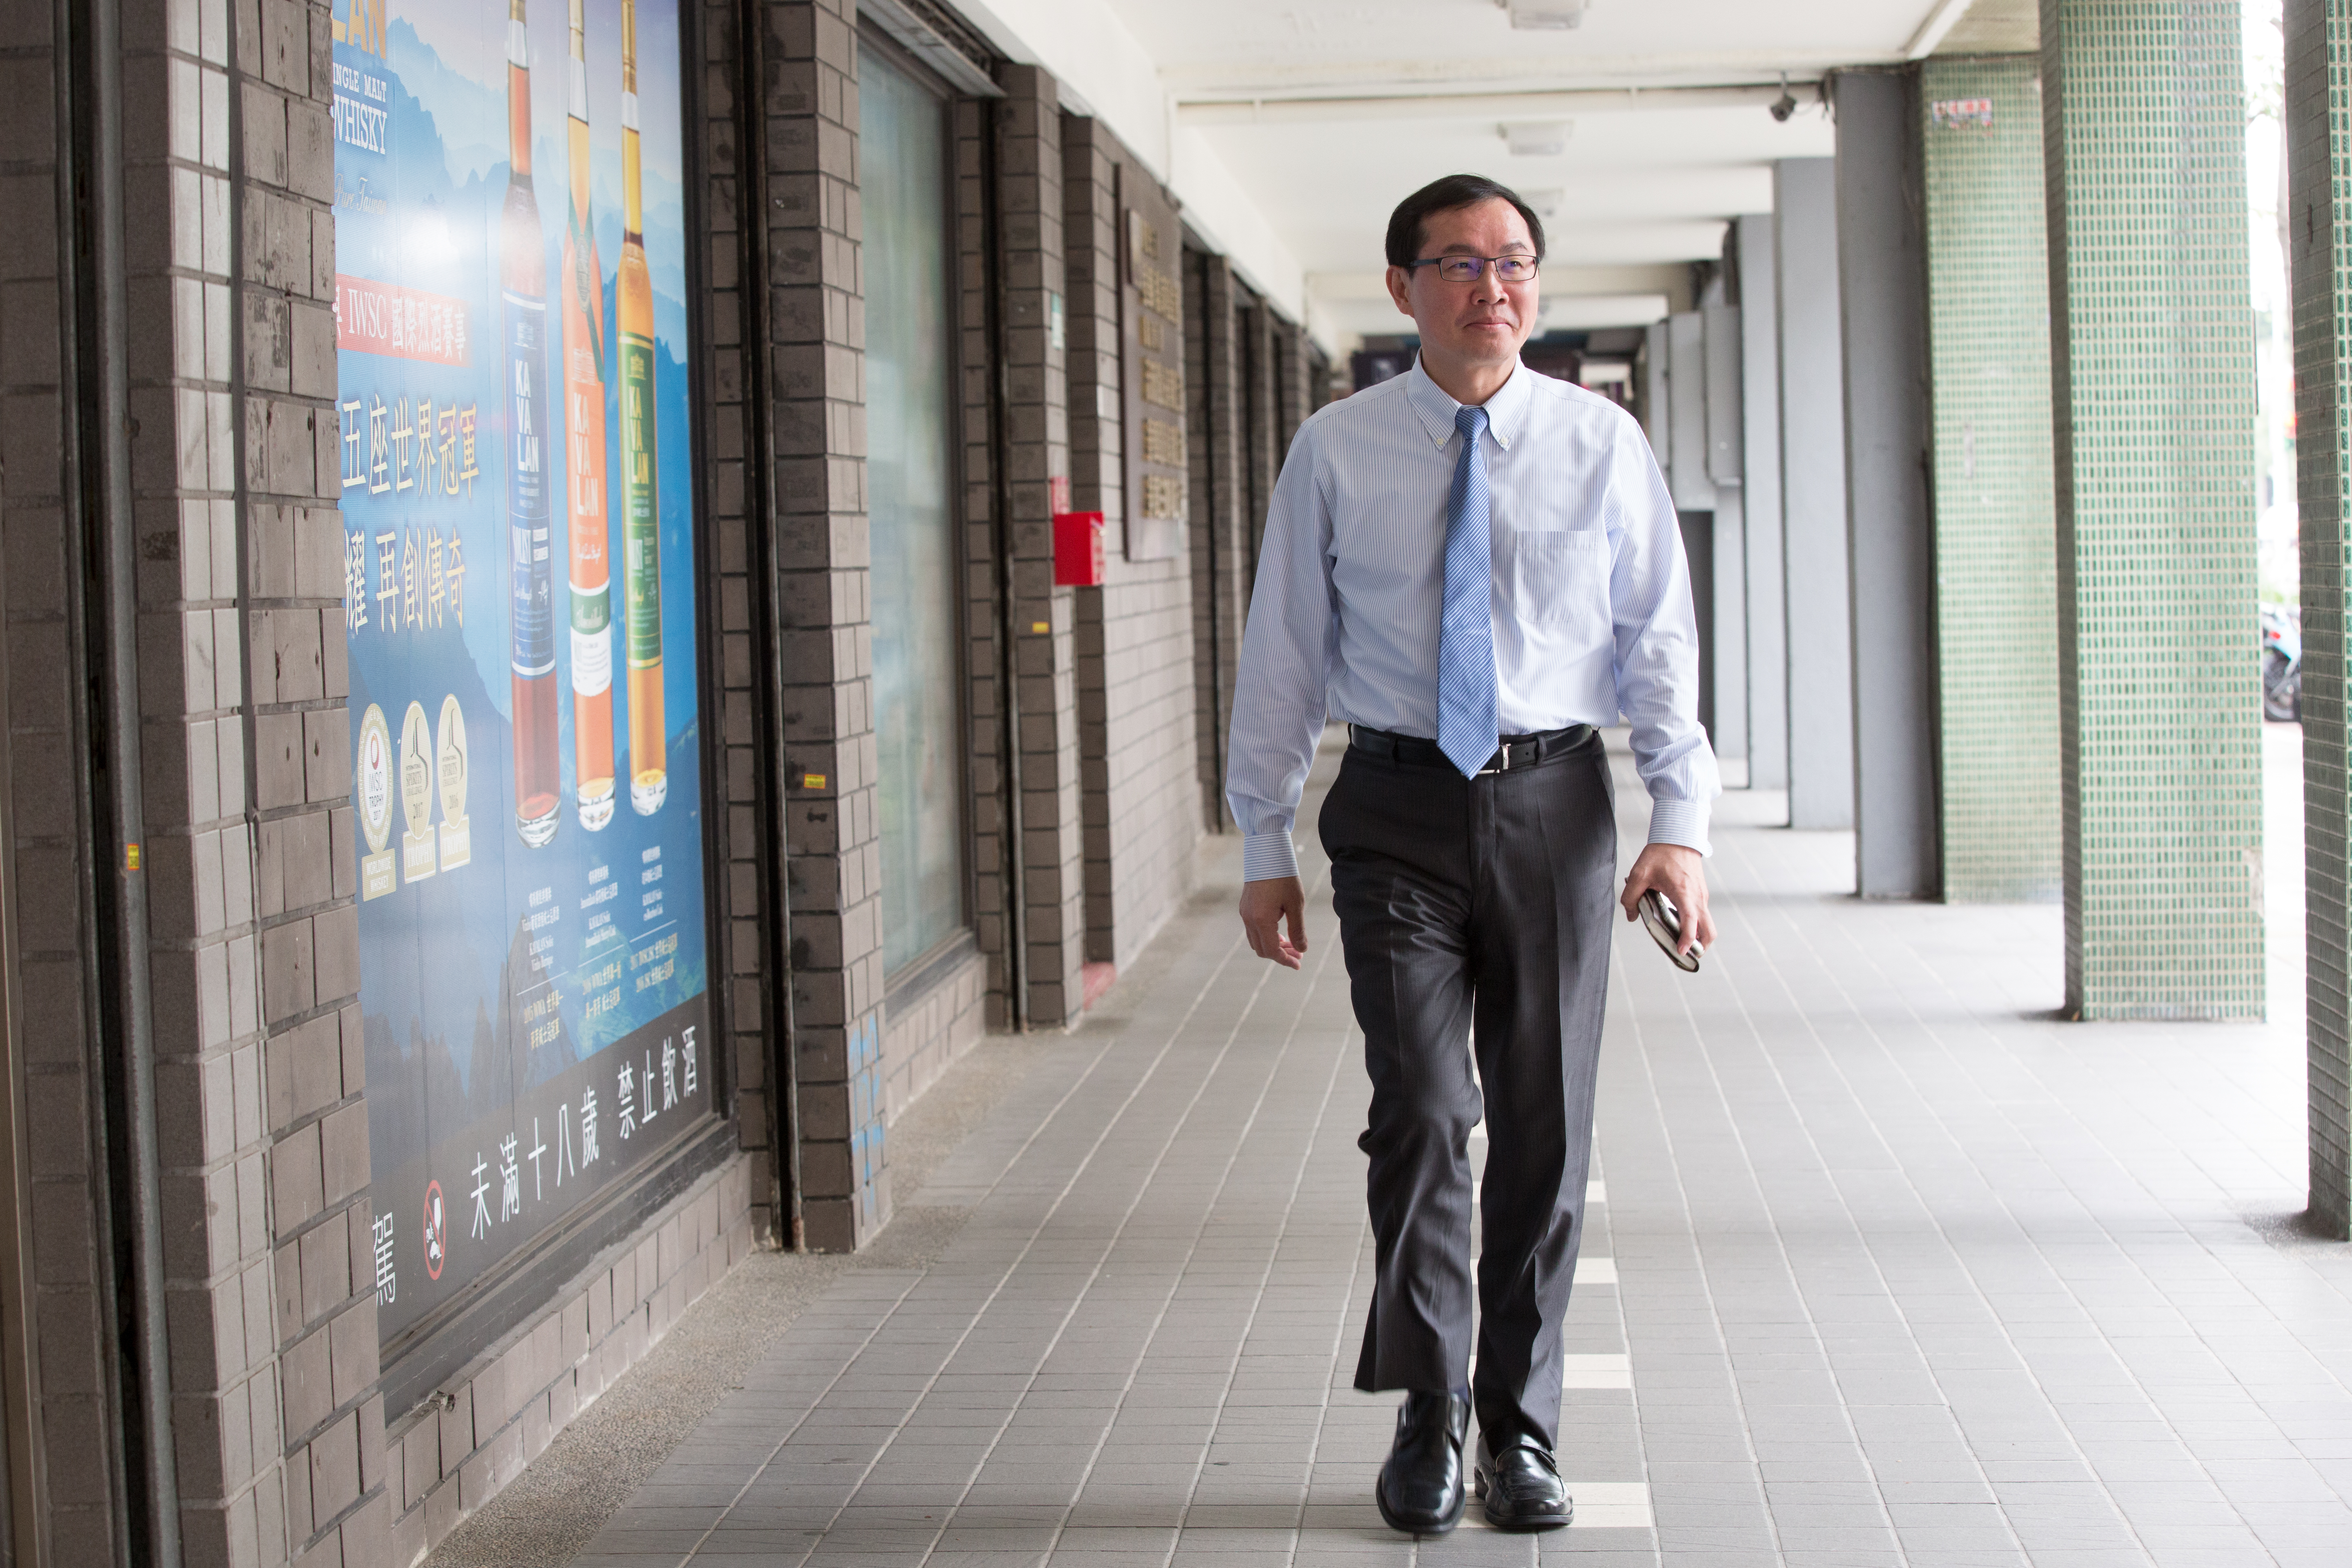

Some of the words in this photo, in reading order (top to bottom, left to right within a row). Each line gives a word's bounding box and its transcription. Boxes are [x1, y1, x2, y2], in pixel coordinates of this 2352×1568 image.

[333, 62, 359, 93] INGLE
[364, 74, 387, 102] MALT
[330, 94, 387, 155] WHISKY
[335, 173, 354, 209] Pure
[348, 288, 387, 340] IWSC
[515, 359, 531, 398] KA
[516, 396, 532, 435] VA
[574, 392, 590, 435] KA
[629, 385, 642, 419] KA
[342, 393, 479, 499] 五座世界冠軍
[517, 433, 539, 472] LAN
[575, 433, 591, 476] VA
[630, 450, 649, 485] LAN
[576, 474, 599, 517] LAN
[376, 527, 466, 634] 再創傳奇
[369, 771, 383, 793] IWSC
[369, 794, 384, 808] TROPHY
[413, 802, 423, 820] 2017
[405, 842, 433, 869] TROPHY
[443, 831, 468, 856] TROPHY
[366, 856, 392, 876] WORLDWIDE
[372, 1212, 396, 1306] 駕
[470, 1085, 600, 1241] 未滿十八歲
[617, 1025, 698, 1140] 禁止飲酒
